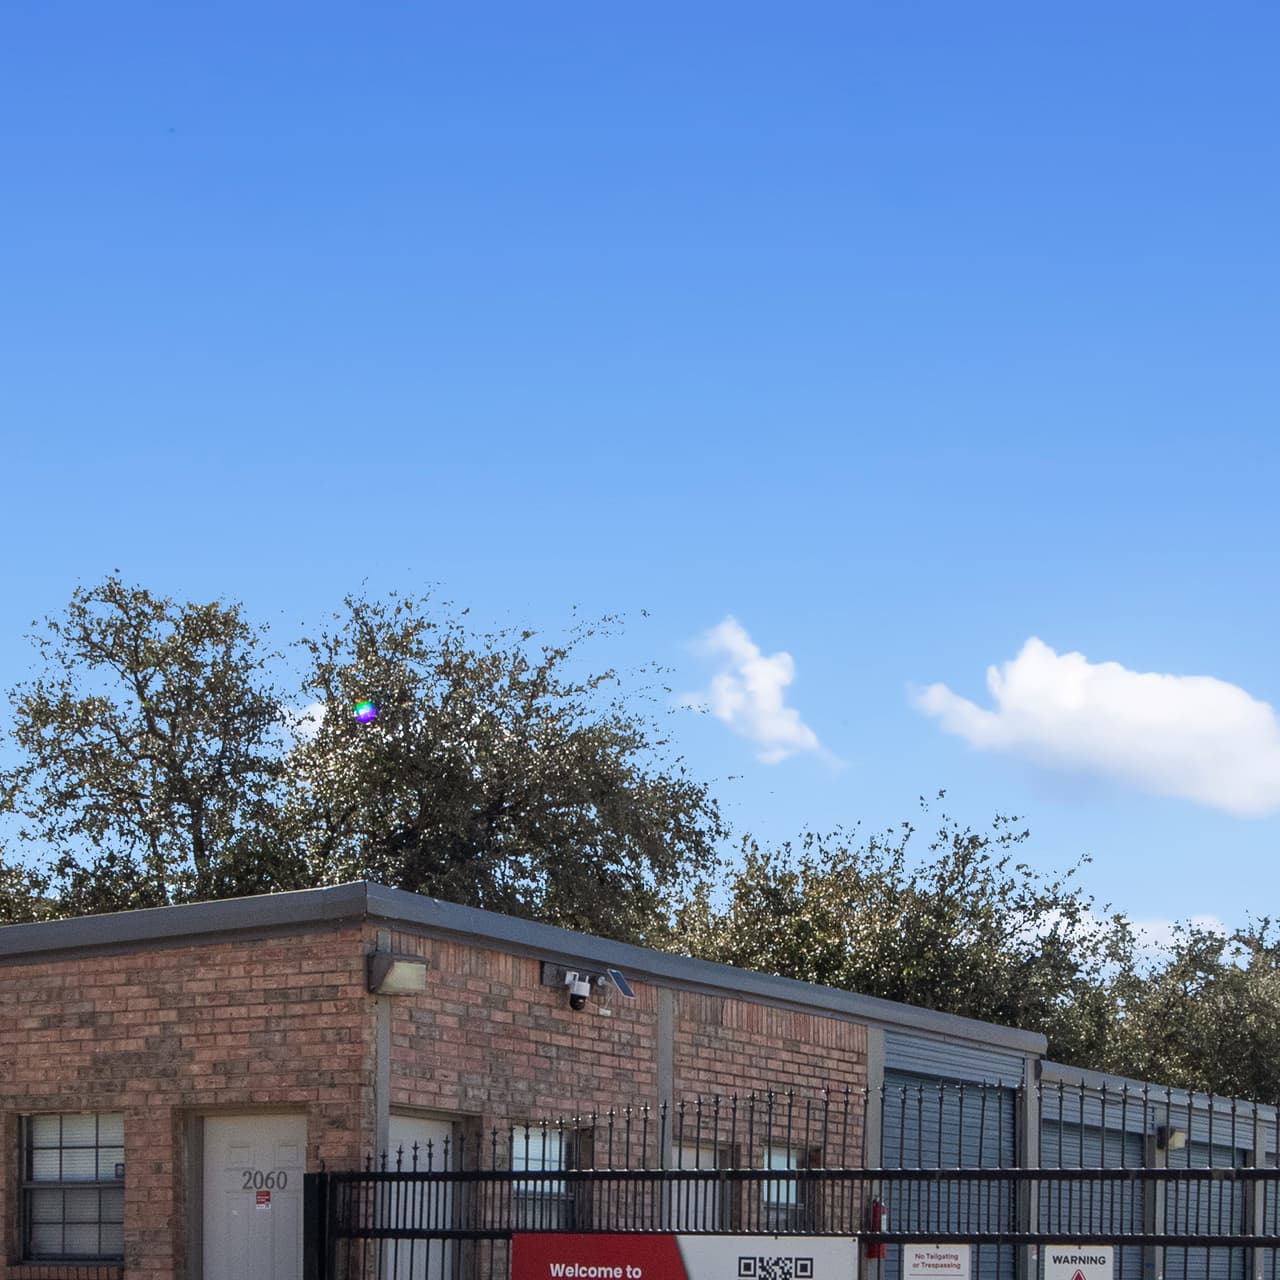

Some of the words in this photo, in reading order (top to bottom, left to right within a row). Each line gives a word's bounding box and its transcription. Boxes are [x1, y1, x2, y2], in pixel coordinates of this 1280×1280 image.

[242, 1170, 288, 1190] 2060
[926, 1253, 959, 1261] Tailgating
[1052, 1255, 1106, 1265] WARNING
[550, 1263, 623, 1279] Welcome
[626, 1265, 642, 1279] to
[921, 1262, 961, 1270] Trespassing
